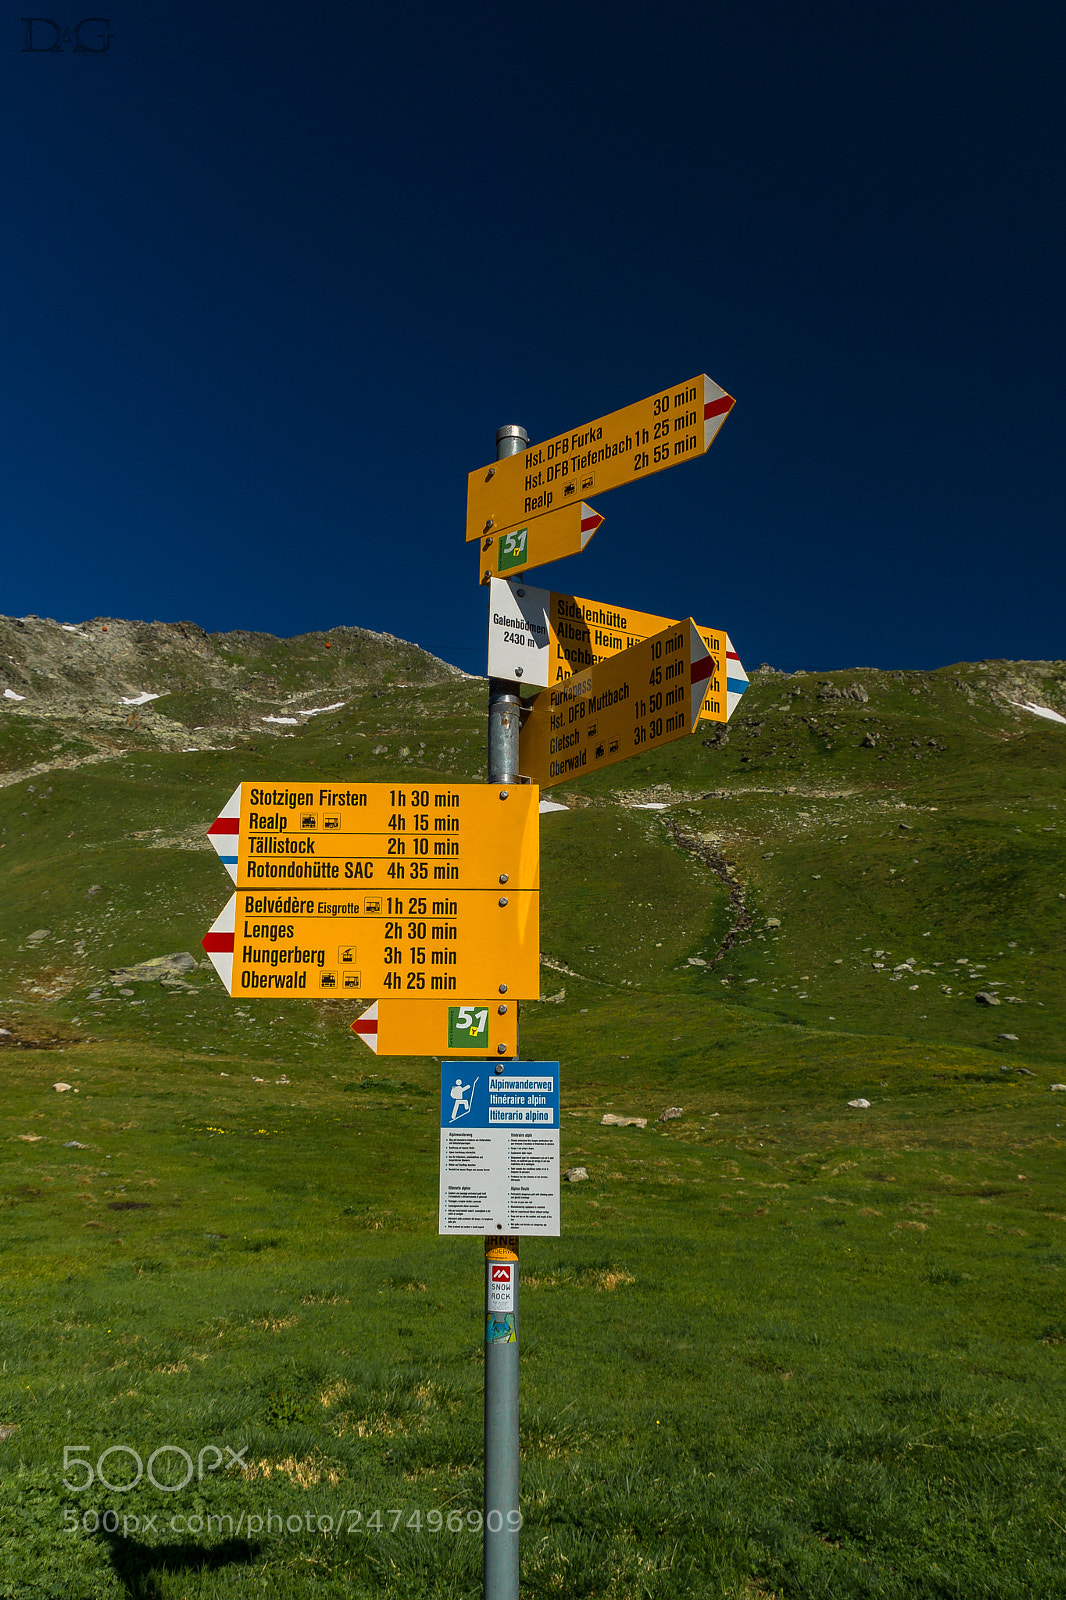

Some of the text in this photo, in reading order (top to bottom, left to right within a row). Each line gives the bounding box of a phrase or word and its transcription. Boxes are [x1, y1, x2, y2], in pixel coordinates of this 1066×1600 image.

[525, 387, 696, 469] Hst. DFB Furka 30 min
[525, 410, 696, 491] Hst. DFB Tiefenbach 1h 25 min
[524, 435, 696, 512] Realp 2h 55 min
[504, 530, 527, 553] 51
[494, 613, 546, 635] Galenbödmen
[558, 600, 627, 629] Sidelenhütte
[504, 632, 534, 647] 2430 m
[557, 622, 590, 646] Albert
[595, 630, 622, 650] Heim
[550, 633, 683, 706] Furkapass 10 min
[550, 659, 684, 732] Hst. DFB Muttbach 45 min
[550, 686, 684, 754] Gletsch 1h 50 min
[550, 711, 684, 777] Oberwald 3h 30 min
[250, 789, 459, 809] Stotzigen Firsten 1h 30 min
[249, 813, 459, 833] Realp 4h 15 min
[248, 837, 459, 855] Tällistock 2h 10 min
[248, 862, 459, 879] Rotondohütte SAC 4h 35 min
[245, 897, 457, 916] Belvédère Eisgrotte 1h 25 min
[244, 921, 457, 941] Lenges 2h 30 min
[243, 946, 456, 966] Hungerberg 3h 15 min
[242, 971, 456, 990] Oberwald 4h 25 min
[456, 1007, 488, 1032] 51
[490, 1079, 552, 1090] Alpinwanderweg
[490, 1094, 546, 1106] Itinéraire alpin
[526, 1110, 548, 1122] alpino
